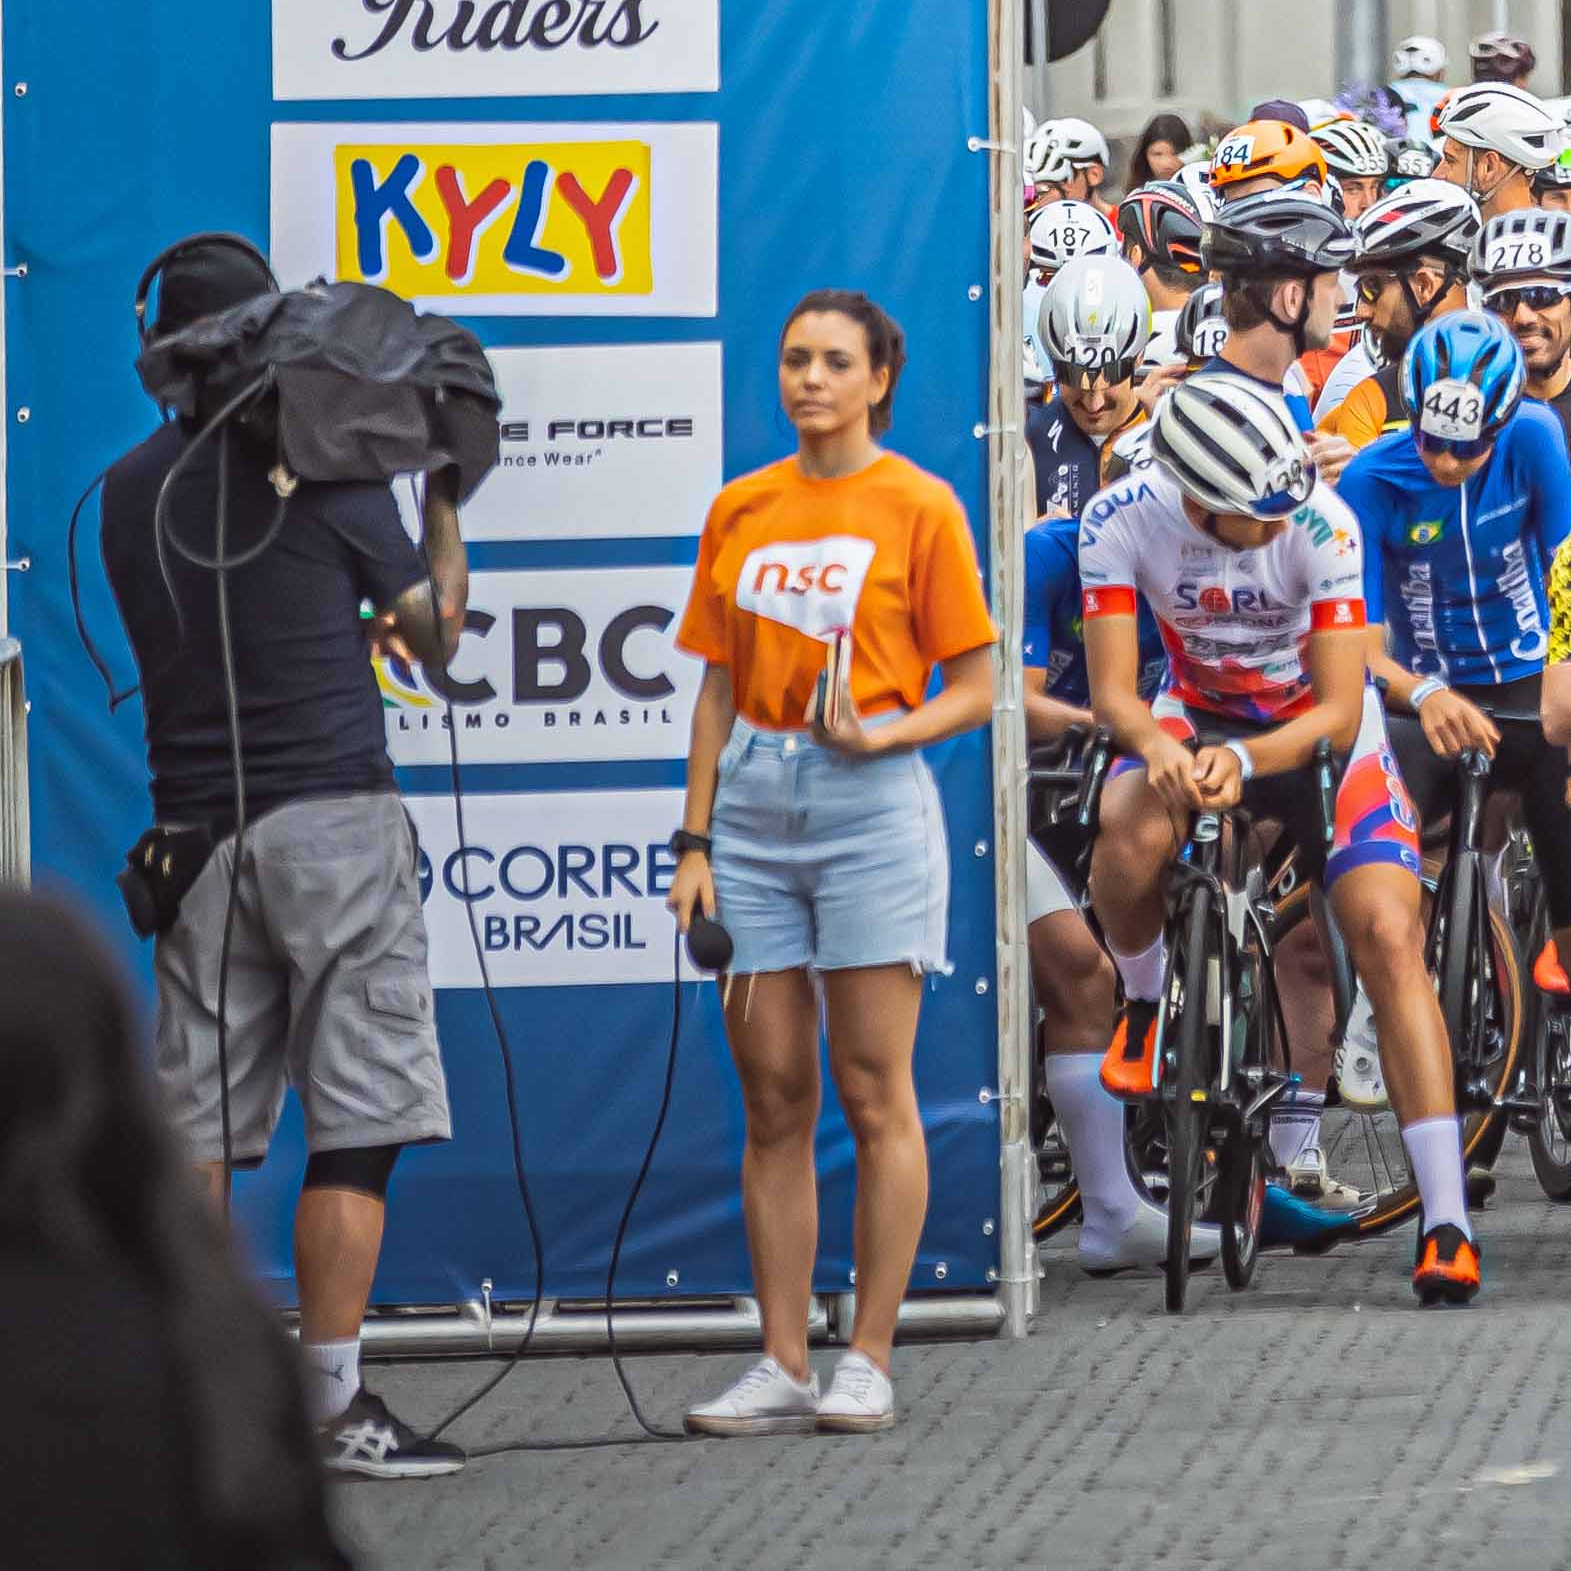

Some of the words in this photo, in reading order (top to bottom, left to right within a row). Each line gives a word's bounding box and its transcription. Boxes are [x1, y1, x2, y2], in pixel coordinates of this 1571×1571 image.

[350, 153, 636, 289] KYLY
[1048, 226, 1091, 249] 187
[1492, 243, 1544, 272] 278
[1425, 391, 1480, 425] 443
[547, 418, 693, 441] FORCE
[751, 562, 849, 594] nsc
[424, 605, 676, 707] CBC
[543, 707, 673, 728] BRASIL
[484, 913, 647, 951] BRASIL
